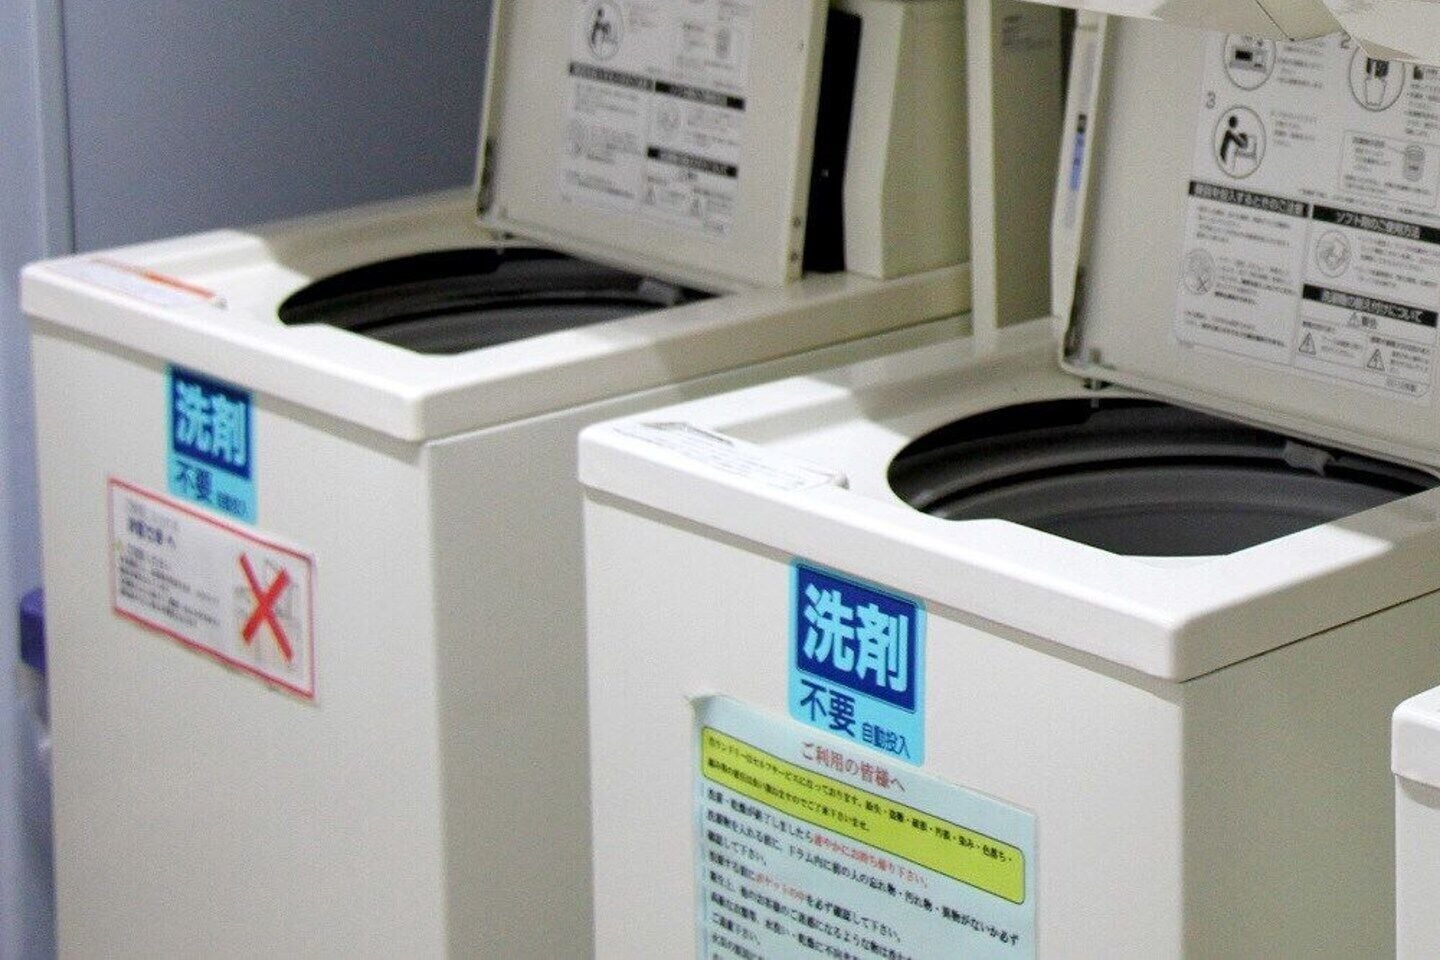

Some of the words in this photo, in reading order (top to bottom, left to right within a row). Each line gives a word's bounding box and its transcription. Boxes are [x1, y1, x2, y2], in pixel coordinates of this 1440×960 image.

[804, 582, 908, 692] 洗剤
[800, 678, 856, 738] 不要
[862, 721, 911, 759] 自動投入
[802, 740, 906, 794] ご利用の皆様へ
